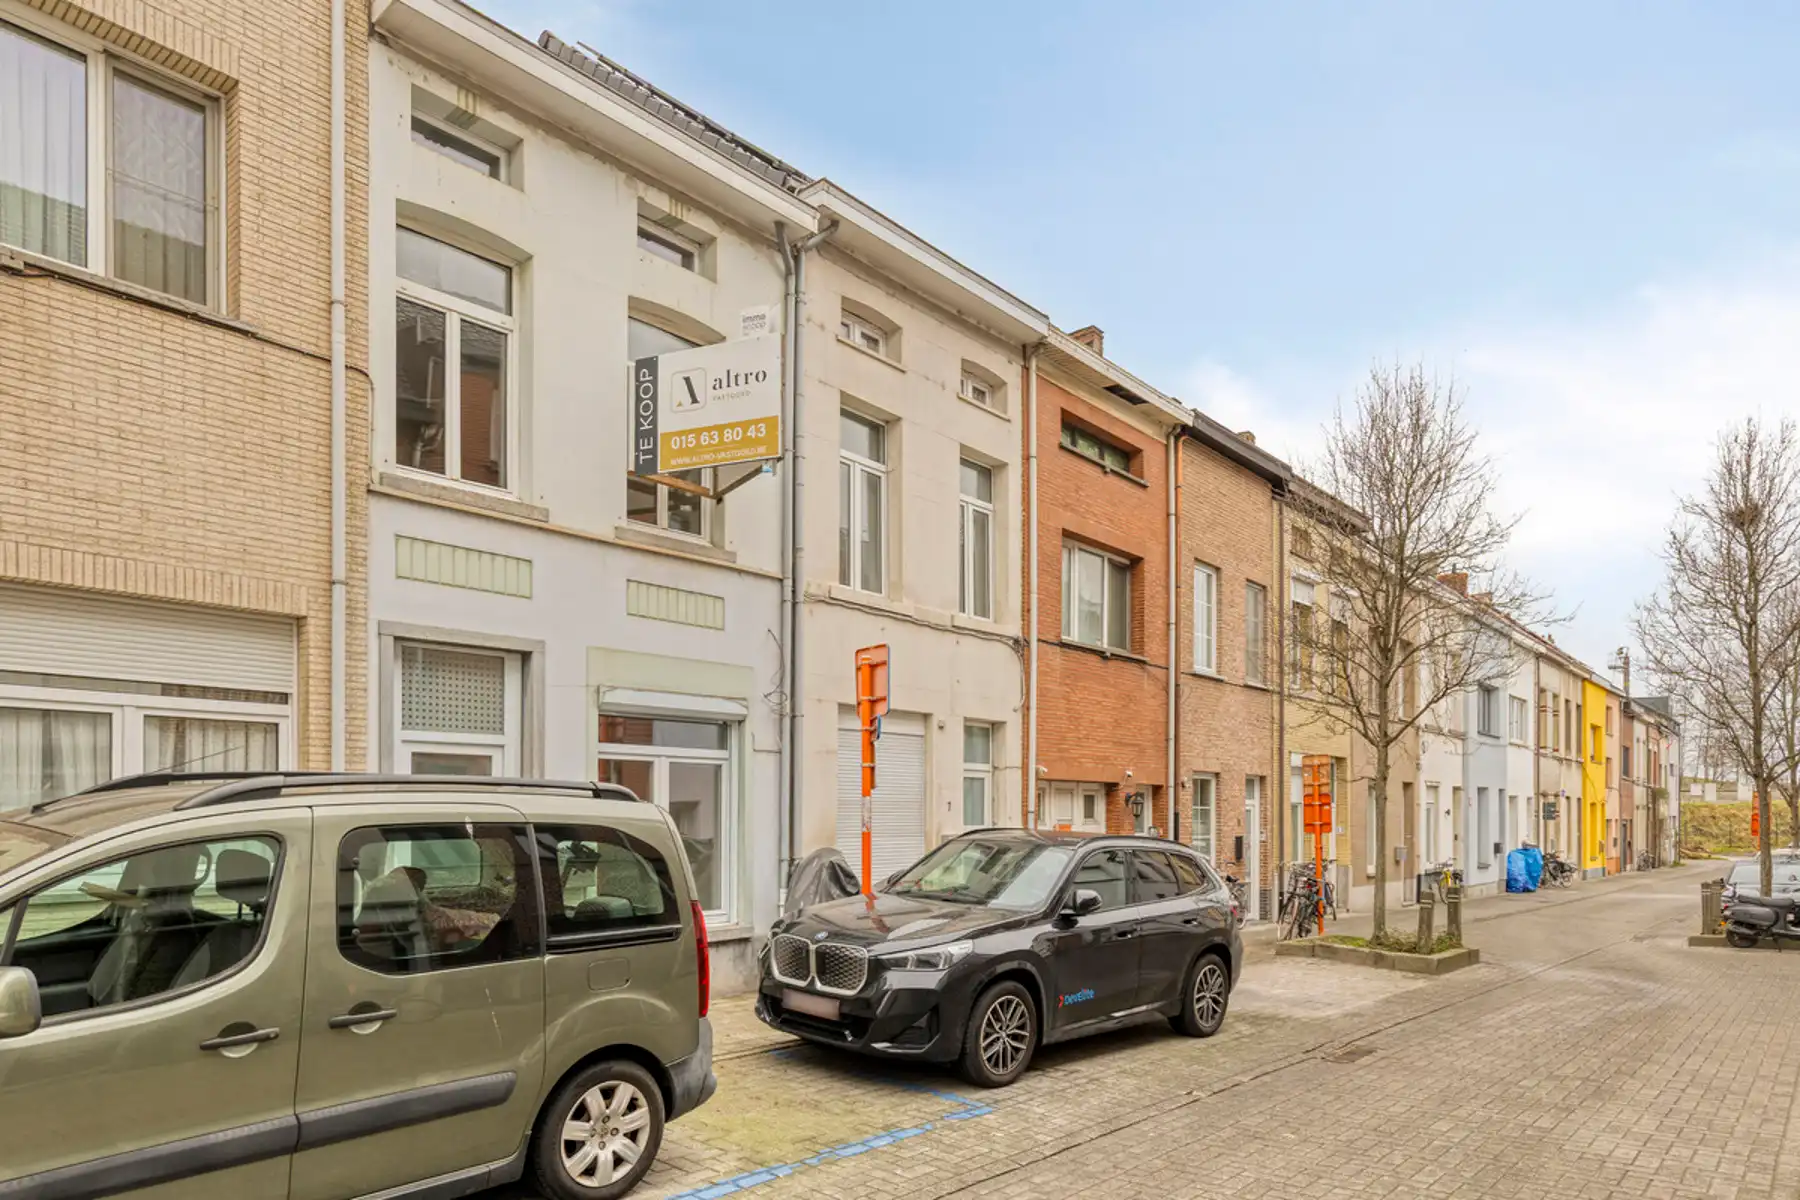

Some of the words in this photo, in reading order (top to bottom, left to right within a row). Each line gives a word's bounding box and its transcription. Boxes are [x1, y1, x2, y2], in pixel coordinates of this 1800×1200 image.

[712, 369, 768, 391] altro
[639, 368, 654, 430] KOOP
[671, 433, 696, 450] 015
[700, 430, 719, 445] 63
[724, 427, 742, 442] 80
[747, 423, 766, 439] 43
[639, 437, 654, 464] TE
